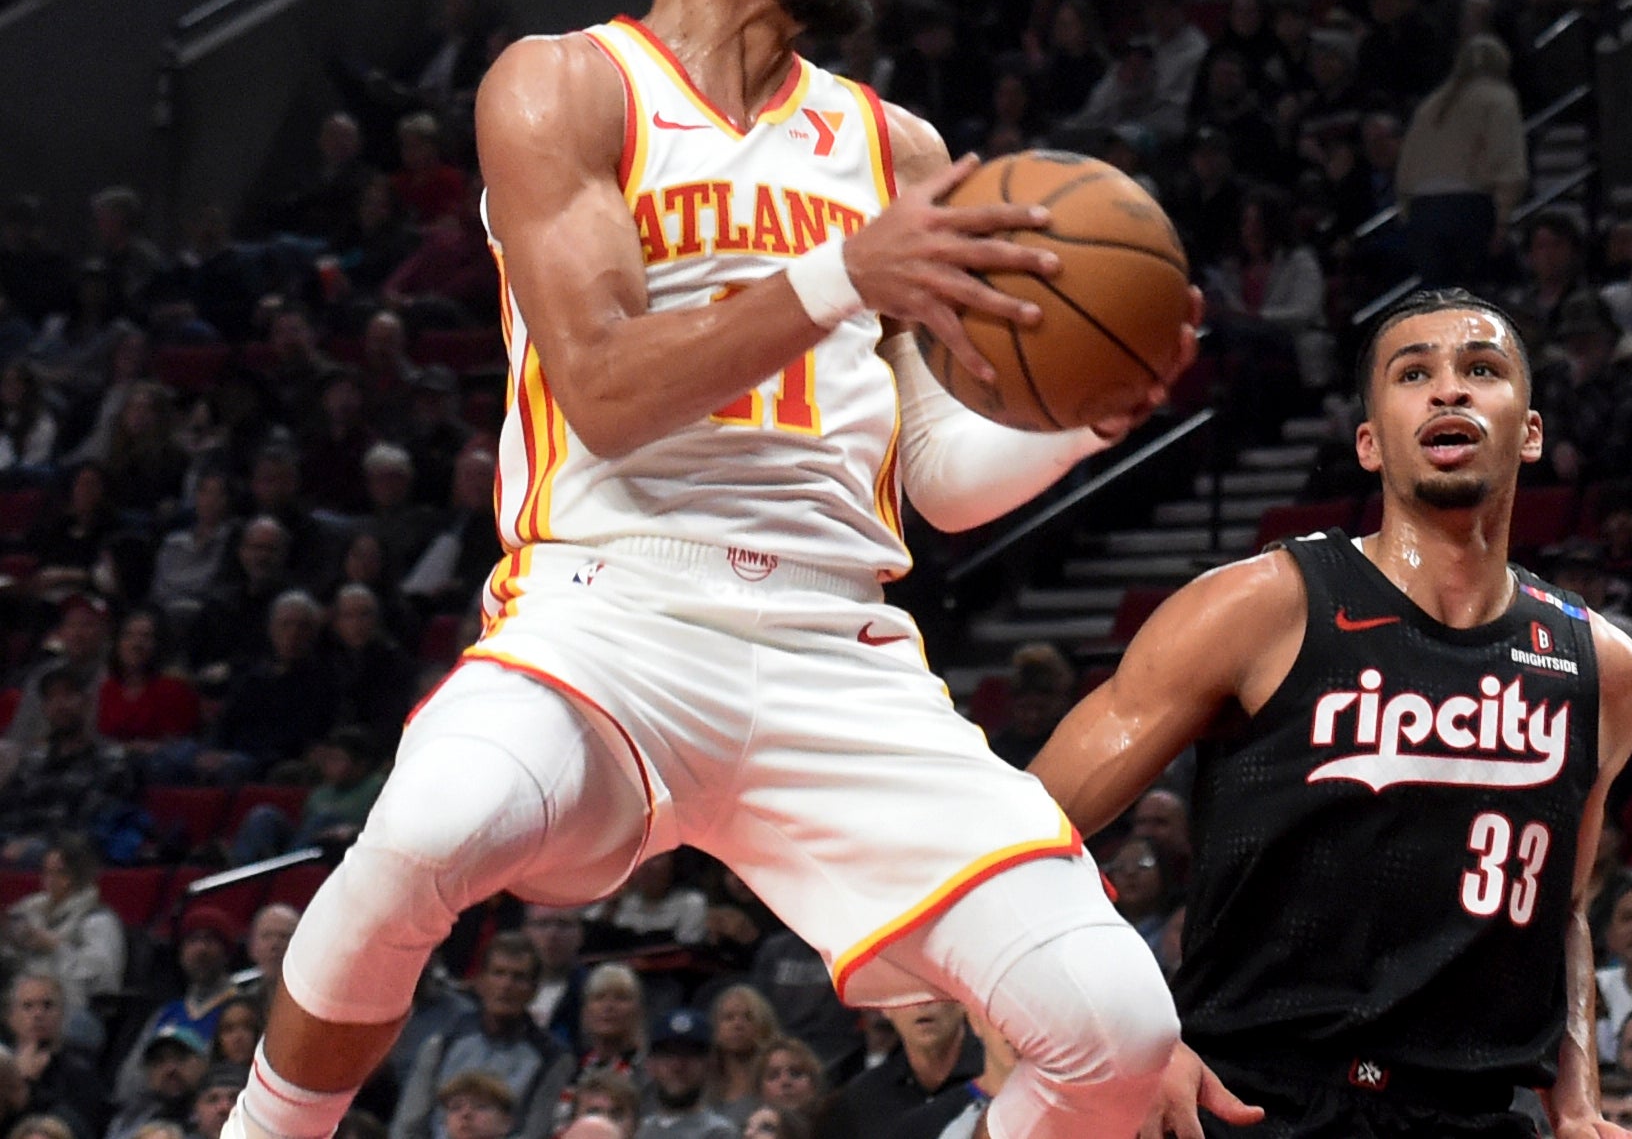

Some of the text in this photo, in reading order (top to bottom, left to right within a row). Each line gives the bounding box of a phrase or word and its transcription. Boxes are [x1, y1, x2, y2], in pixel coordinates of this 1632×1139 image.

[633, 180, 868, 265] ATLANT
[726, 546, 779, 569] HAWKS
[1510, 647, 1579, 676] BRIGHTSIDE
[1458, 808, 1553, 929] 33
